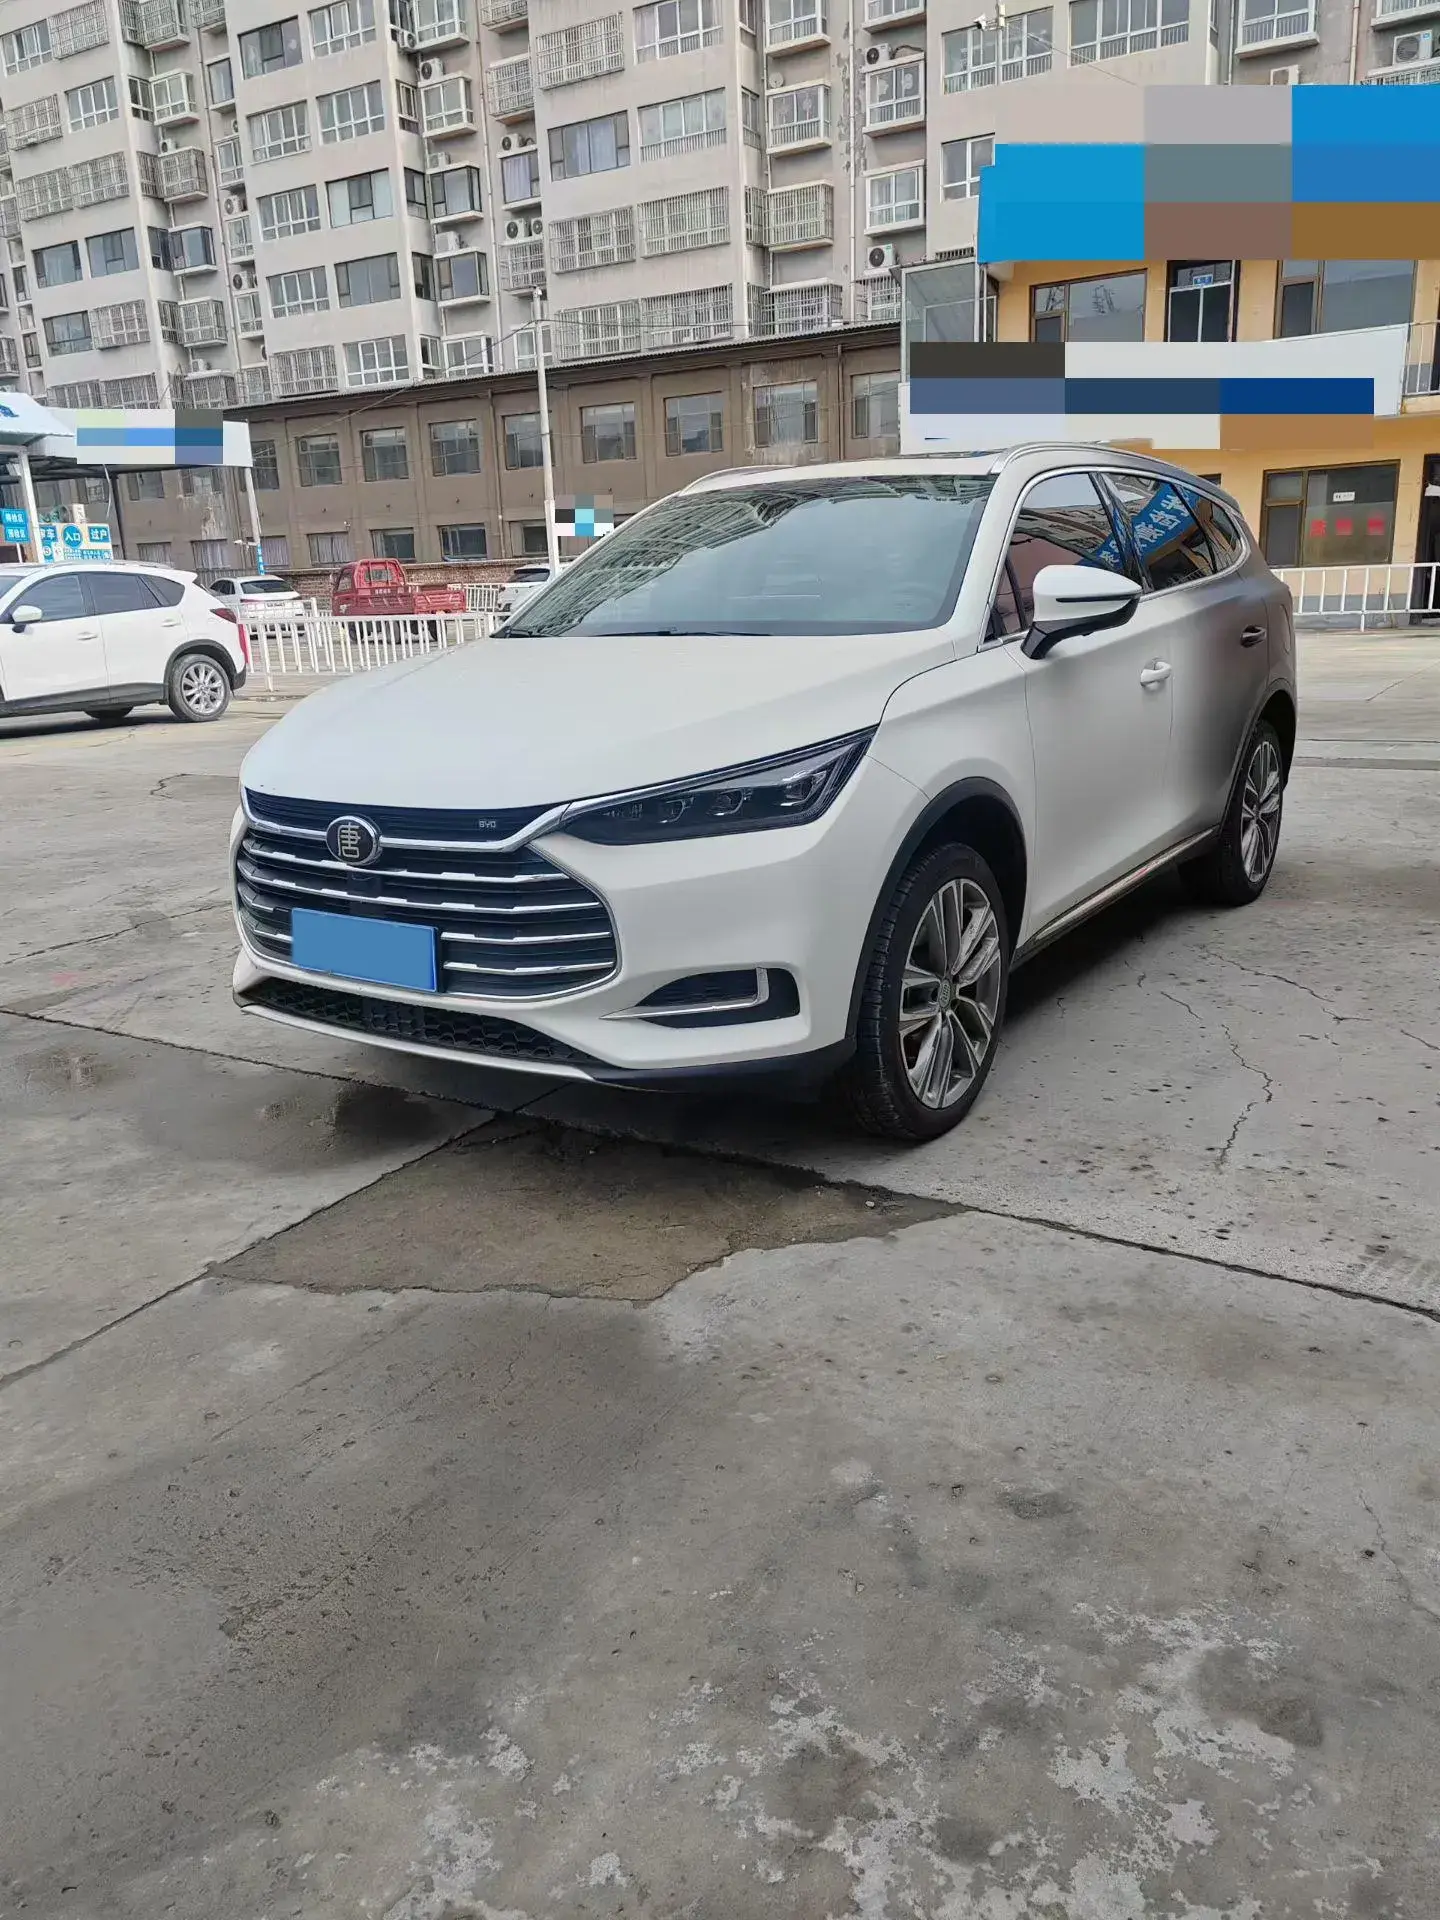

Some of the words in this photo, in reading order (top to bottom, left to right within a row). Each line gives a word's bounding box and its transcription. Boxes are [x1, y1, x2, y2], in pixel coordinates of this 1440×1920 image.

[65, 532, 81, 541] 入口
[479, 820, 496, 828] BYD
[338, 822, 361, 858] 唐
